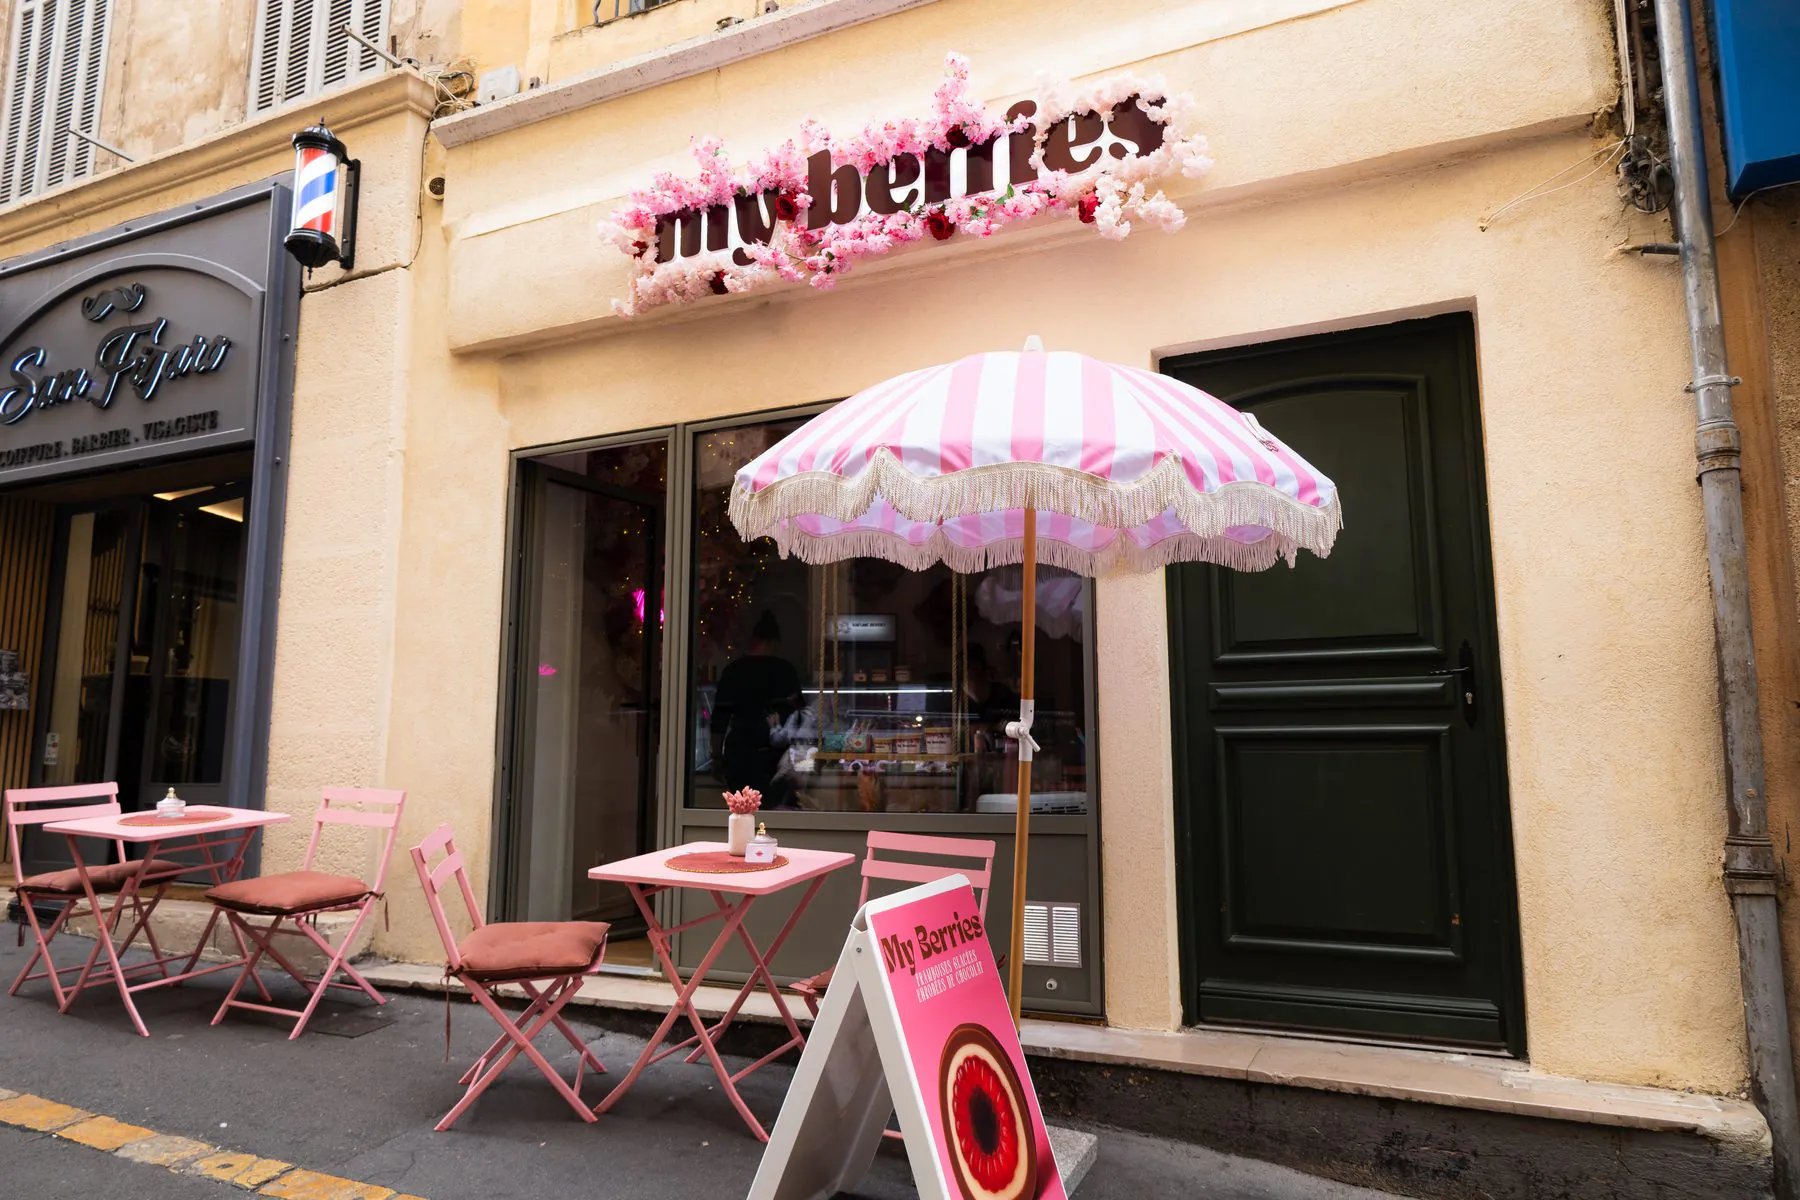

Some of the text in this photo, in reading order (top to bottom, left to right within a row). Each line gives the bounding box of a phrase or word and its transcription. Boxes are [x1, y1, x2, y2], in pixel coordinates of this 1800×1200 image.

[656, 94, 1168, 266] my berries
[72, 428, 131, 455] BARBIER
[143, 410, 219, 441] VISAGISTE
[880, 911, 983, 976] My Berries
[915, 960, 953, 988] FRAMBOISES
[946, 973, 956, 989] DE
[955, 960, 984, 985] CHOCOLAT
